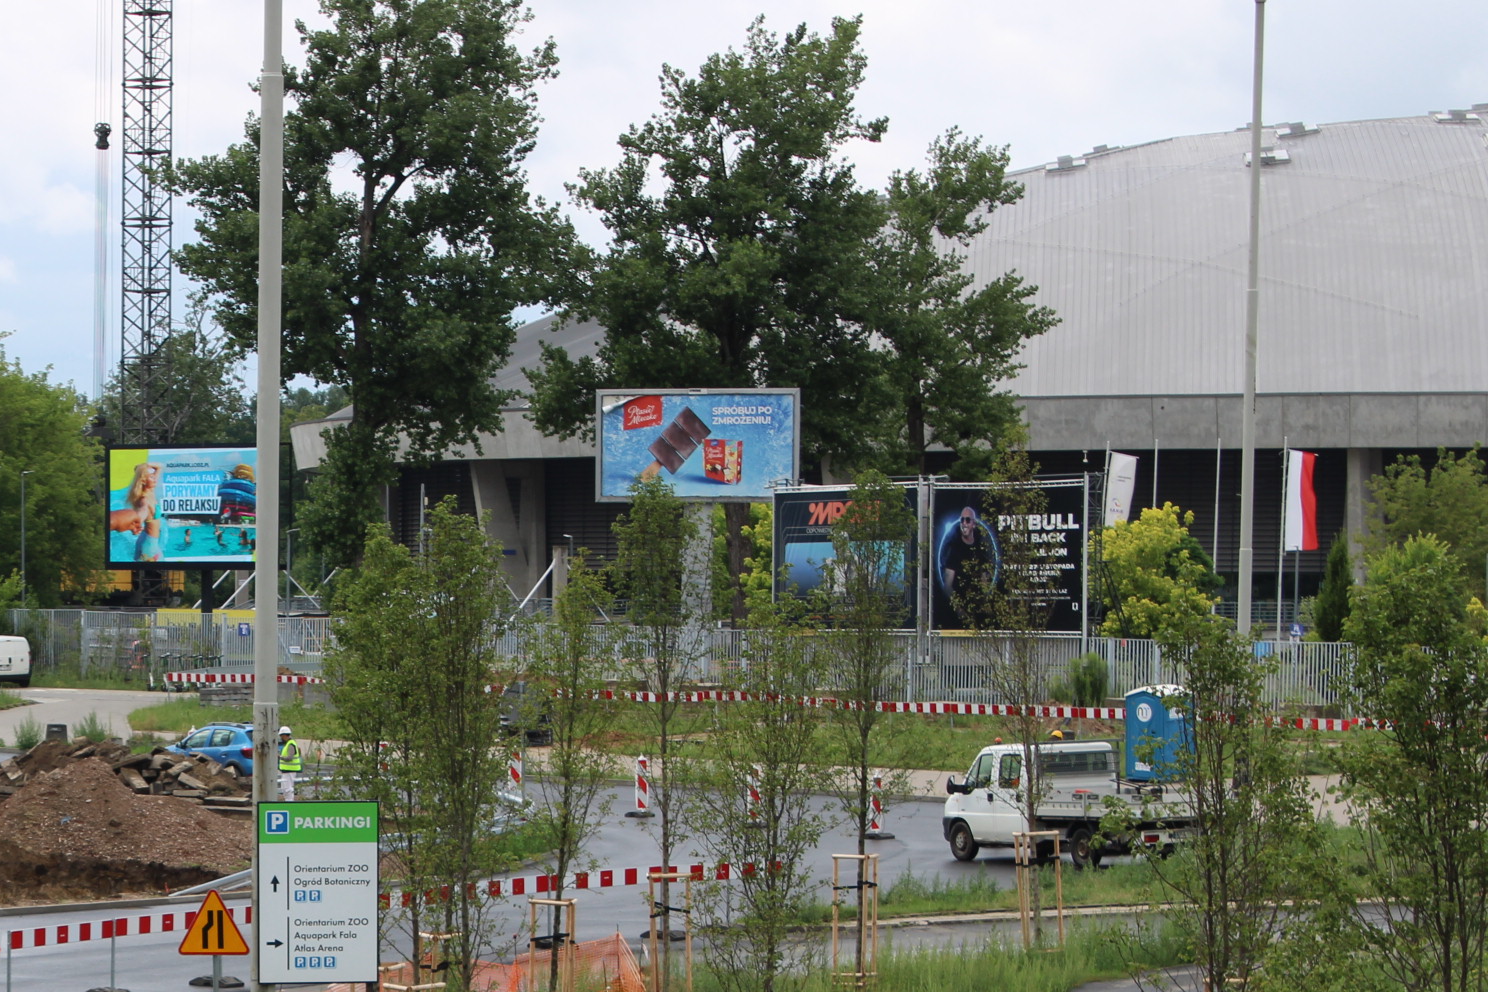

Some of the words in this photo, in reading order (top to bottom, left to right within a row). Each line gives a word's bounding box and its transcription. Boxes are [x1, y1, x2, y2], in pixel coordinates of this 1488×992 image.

[712, 405, 756, 415] SPRÓBUJ
[758, 406, 772, 414] PO
[165, 474, 201, 483] Aquapark
[202, 474, 220, 482] FALA
[165, 485, 216, 497] PORYWAMY
[163, 499, 175, 512] DO
[178, 498, 219, 512] RELAKSU
[1031, 532, 1066, 543] BACK
[271, 813, 284, 830] P
[294, 816, 371, 829] PARKINGI
[294, 865, 346, 873] Orientarium
[348, 864, 369, 872] ZOO
[294, 877, 322, 887] Ogród
[324, 877, 371, 887] Botaniczny
[294, 918, 346, 927] Orientarium
[348, 918, 369, 926] ZOO
[294, 931, 337, 941] Aquapark
[339, 931, 357, 939] Fala
[294, 944, 315, 952] Atlas
[317, 944, 344, 952] Arena
